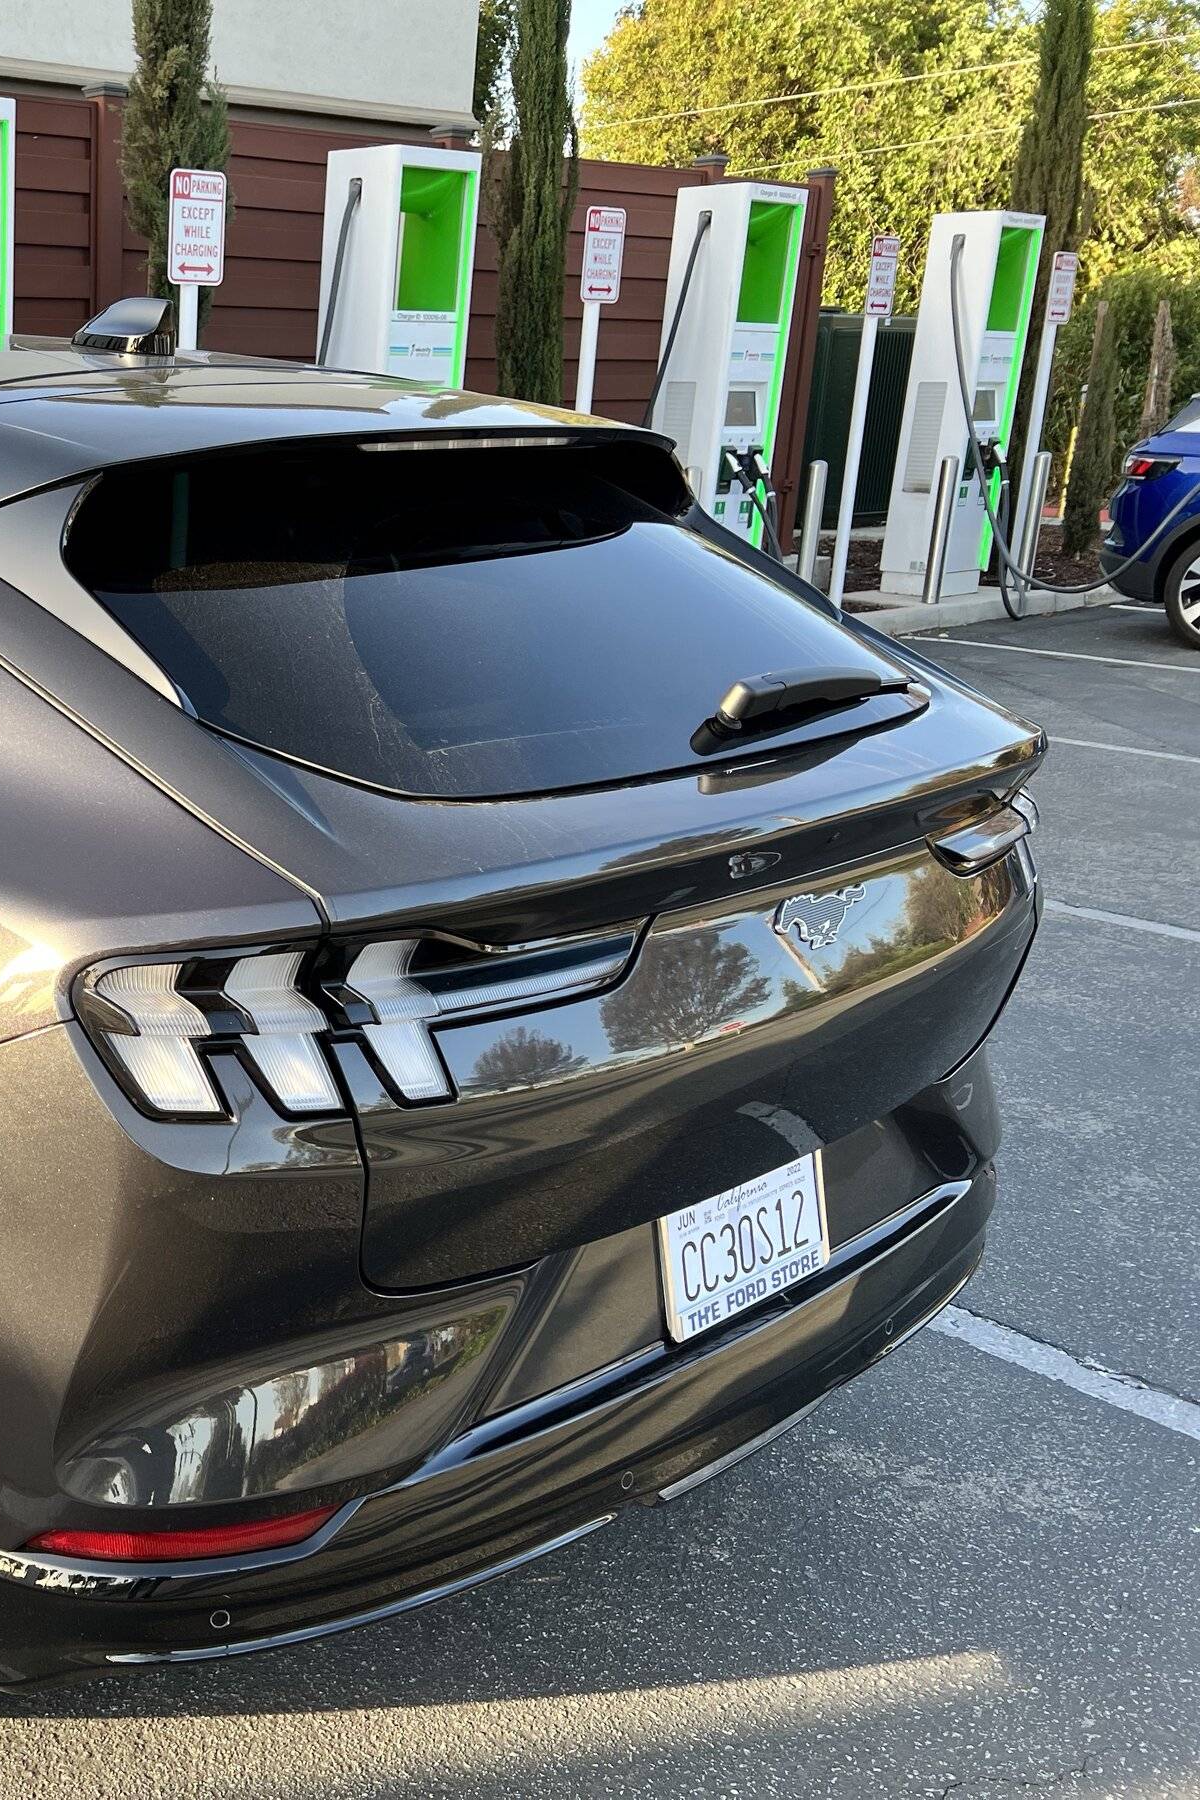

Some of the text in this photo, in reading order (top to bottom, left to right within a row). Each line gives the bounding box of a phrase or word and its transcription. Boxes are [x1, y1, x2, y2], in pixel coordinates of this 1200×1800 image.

[175, 176, 222, 196] NO PARKING
[181, 206, 215, 222] EXCEPT
[590, 212, 600, 228] NO
[184, 225, 211, 239] WHILE
[175, 243, 218, 258] CHARGING
[592, 238, 616, 250] EXCEPT
[592, 253, 612, 265] WHILE
[586, 268, 617, 280] CHARGING
[786, 1162, 801, 1176] 2022
[717, 1182, 767, 1212] California
[678, 1210, 696, 1231] JUN
[681, 1190, 809, 1302] CC30S12
[688, 1249, 820, 1332] THE FORD STORE
